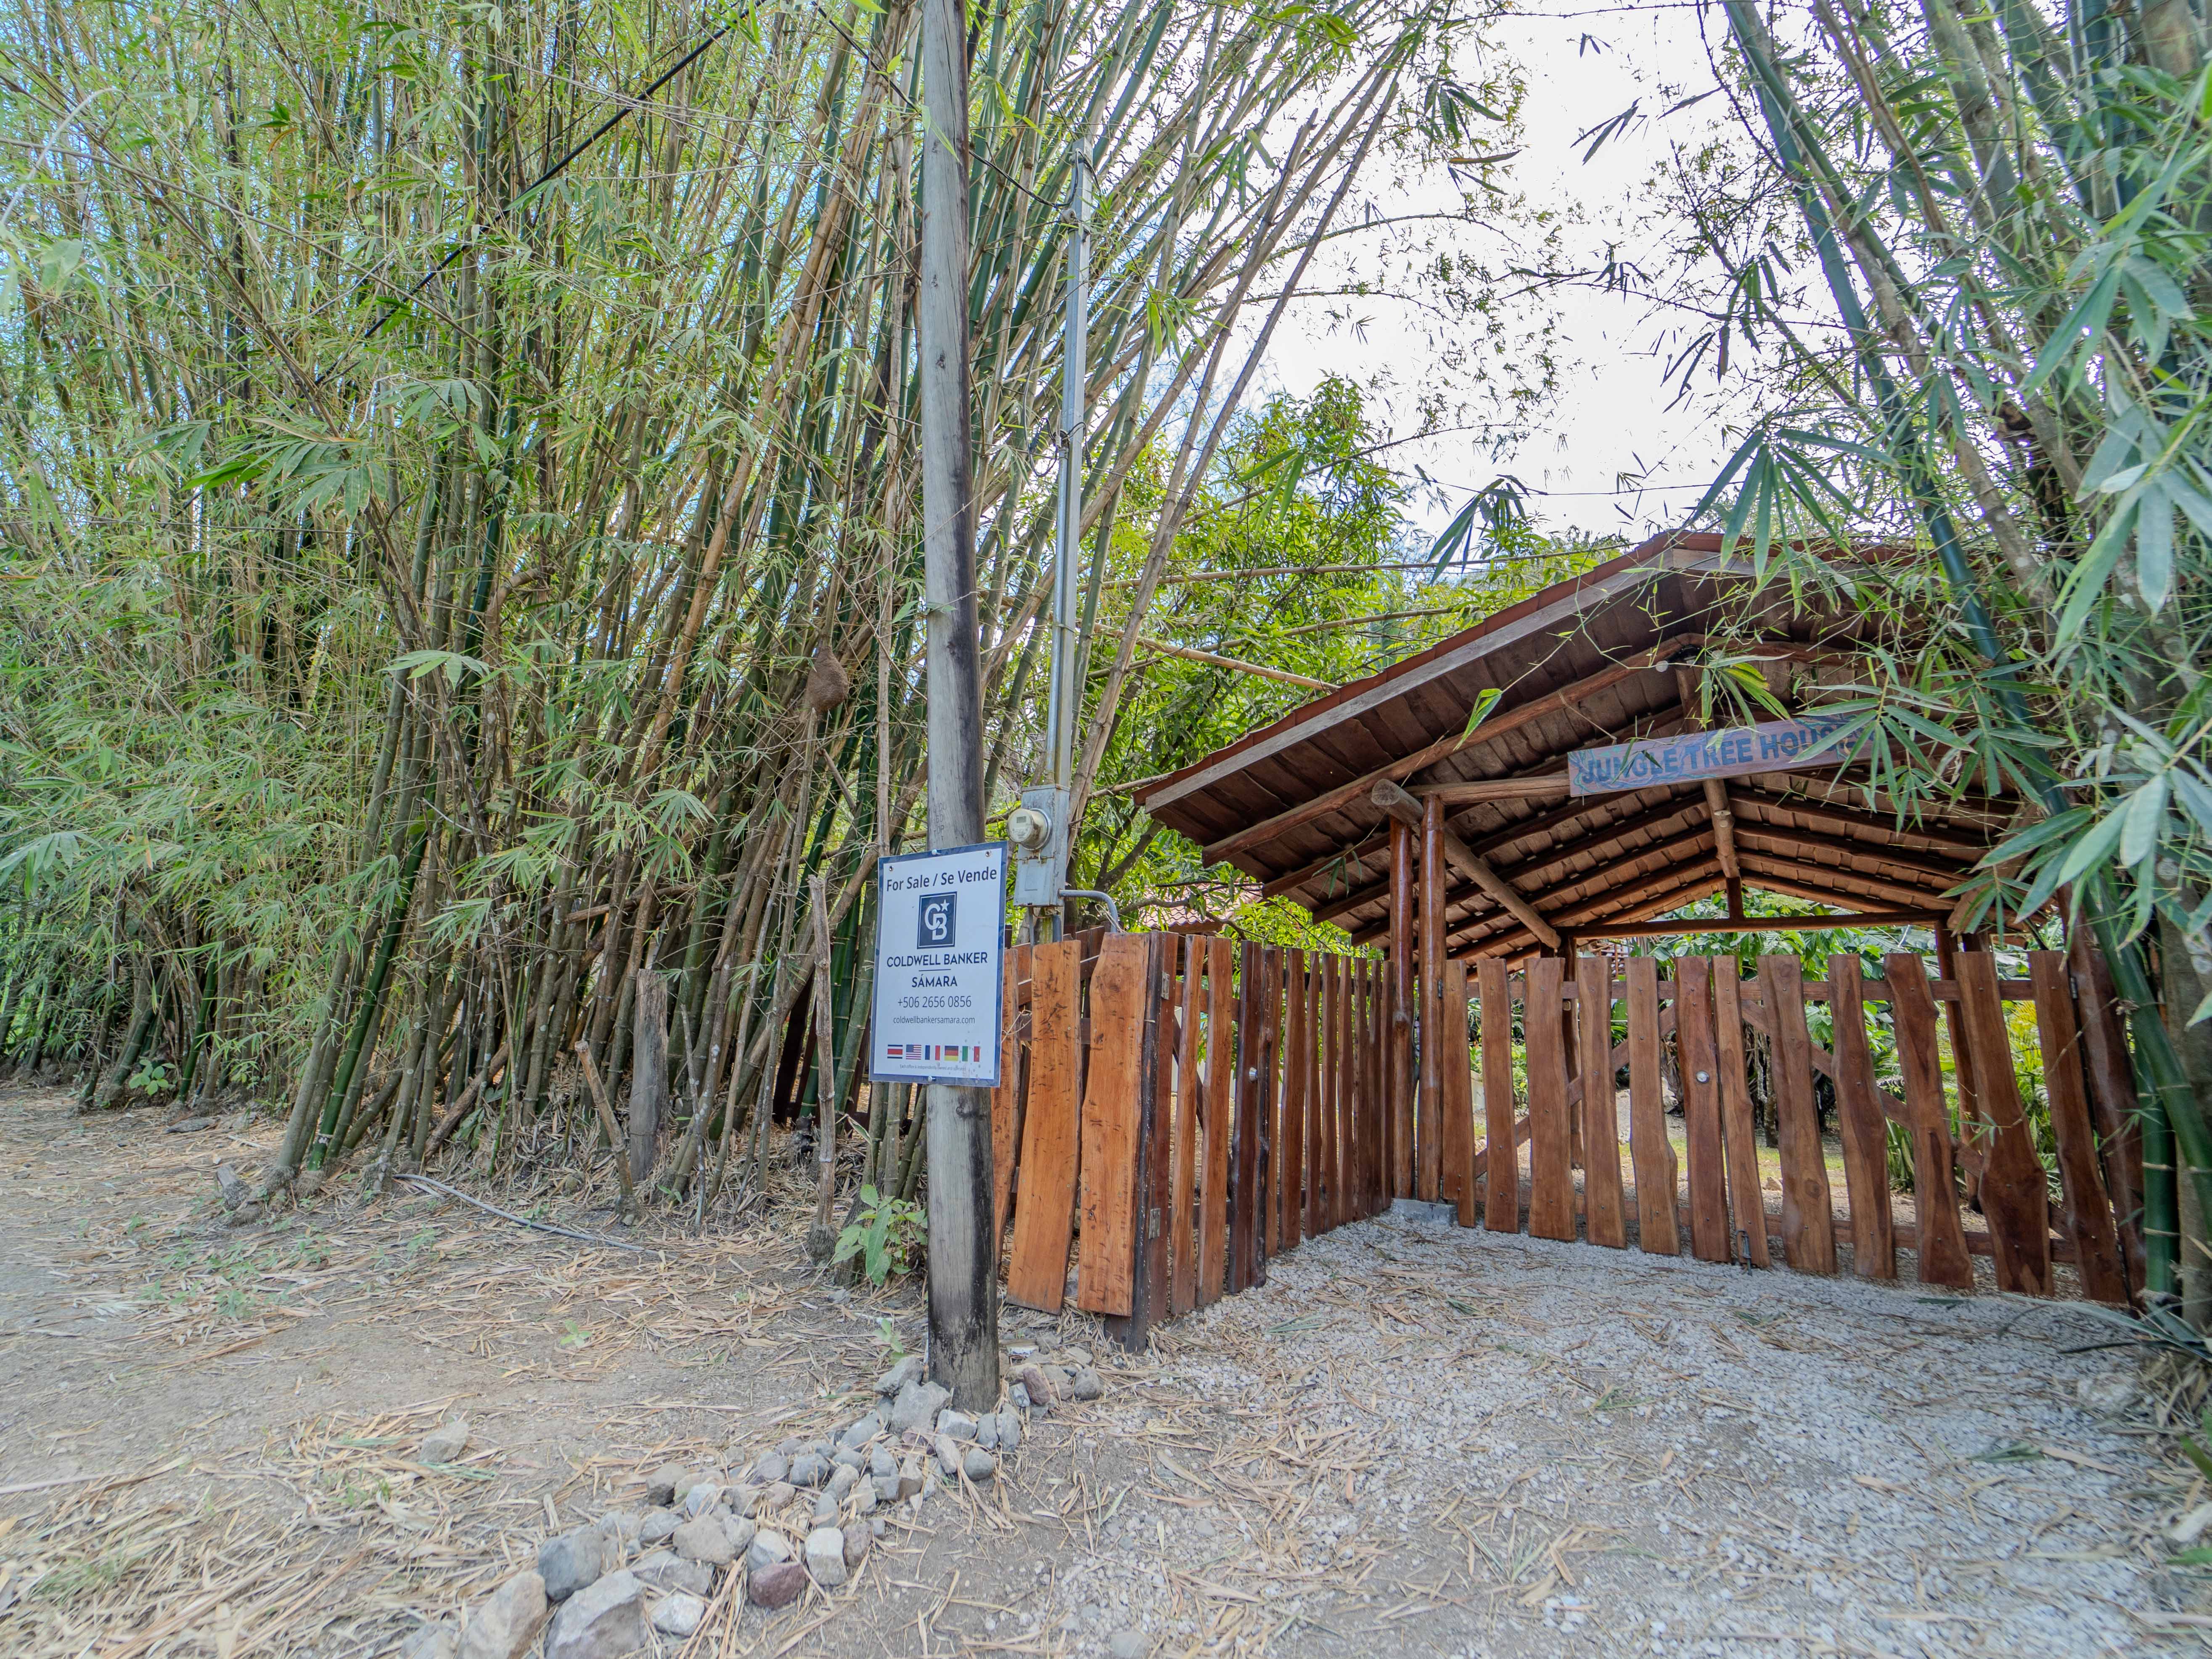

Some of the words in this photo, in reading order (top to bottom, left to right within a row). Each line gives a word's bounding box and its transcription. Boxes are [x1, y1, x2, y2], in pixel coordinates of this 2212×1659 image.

[1582, 749, 1677, 783] JUNGLE
[1683, 738, 1753, 769] TREE
[887, 879, 903, 892] For
[907, 875, 929, 889] Sale
[933, 874, 938, 886] /
[941, 873, 954, 885] Se
[958, 867, 997, 883] Vende
[887, 954, 941, 967] COLDWELL
[944, 952, 988, 965] BANKER
[912, 974, 958, 987] SÁMARA
[898, 997, 920, 1008] +506
[922, 996, 945, 1008] 2656
[948, 996, 971, 1007] 0856
